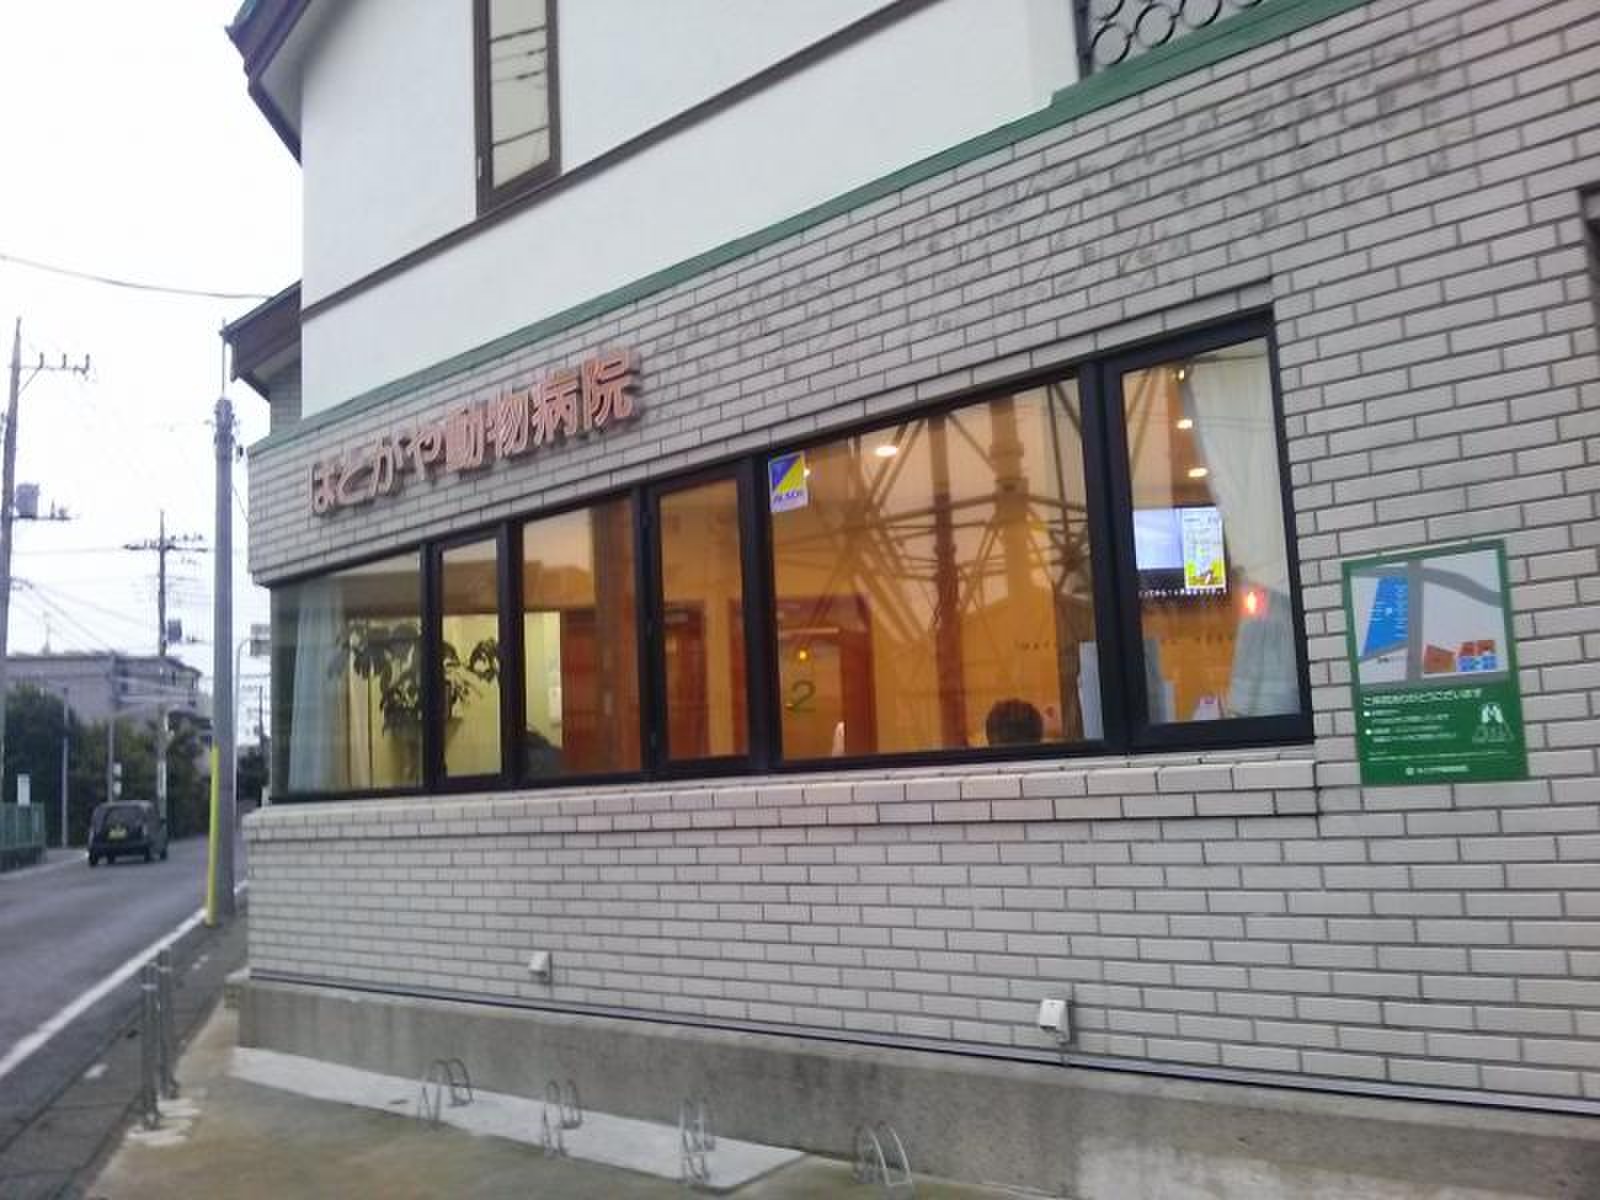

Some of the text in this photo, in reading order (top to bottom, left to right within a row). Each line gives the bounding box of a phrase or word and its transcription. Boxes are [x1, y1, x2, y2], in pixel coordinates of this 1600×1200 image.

[306, 348, 638, 514] はとがや動物病院
